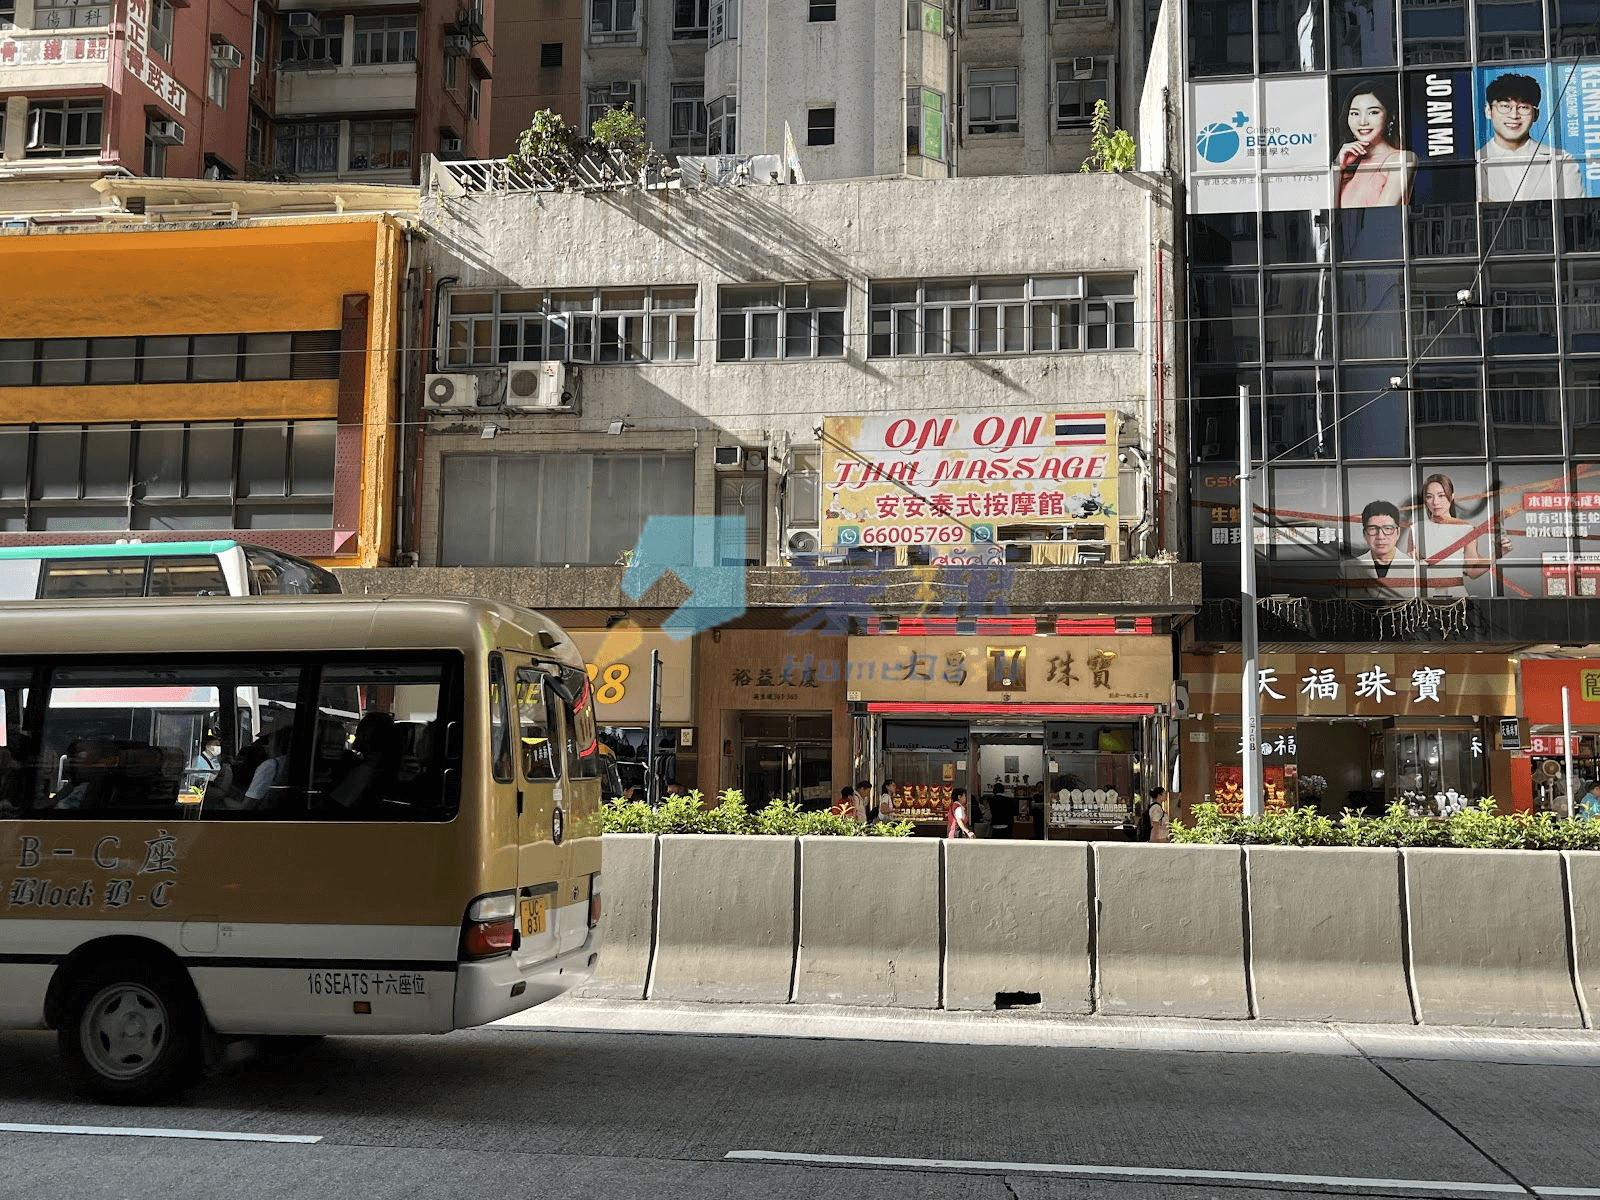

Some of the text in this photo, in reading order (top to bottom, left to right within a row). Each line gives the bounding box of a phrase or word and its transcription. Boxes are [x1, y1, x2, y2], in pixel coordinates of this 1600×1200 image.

[46, 8, 102, 28] 傷科
[1426, 74, 1453, 157] JO AN MA
[1246, 126, 1281, 135] College
[1567, 119, 1579, 138] TEAM
[1246, 133, 1312, 147] BEACON
[884, 416, 1043, 455] ON ON
[827, 455, 1107, 489] THAI MASSAGE
[875, 491, 1065, 519] 安安泰式按摩館
[863, 526, 964, 544] 66005769
[732, 667, 819, 689] 裕益大廈
[1047, 648, 1118, 690] 珠寶
[8, 878, 176, 910] Block B-C
[527, 916, 541, 935] 831
[307, 972, 426, 995] 16 SEATS 十六座位
